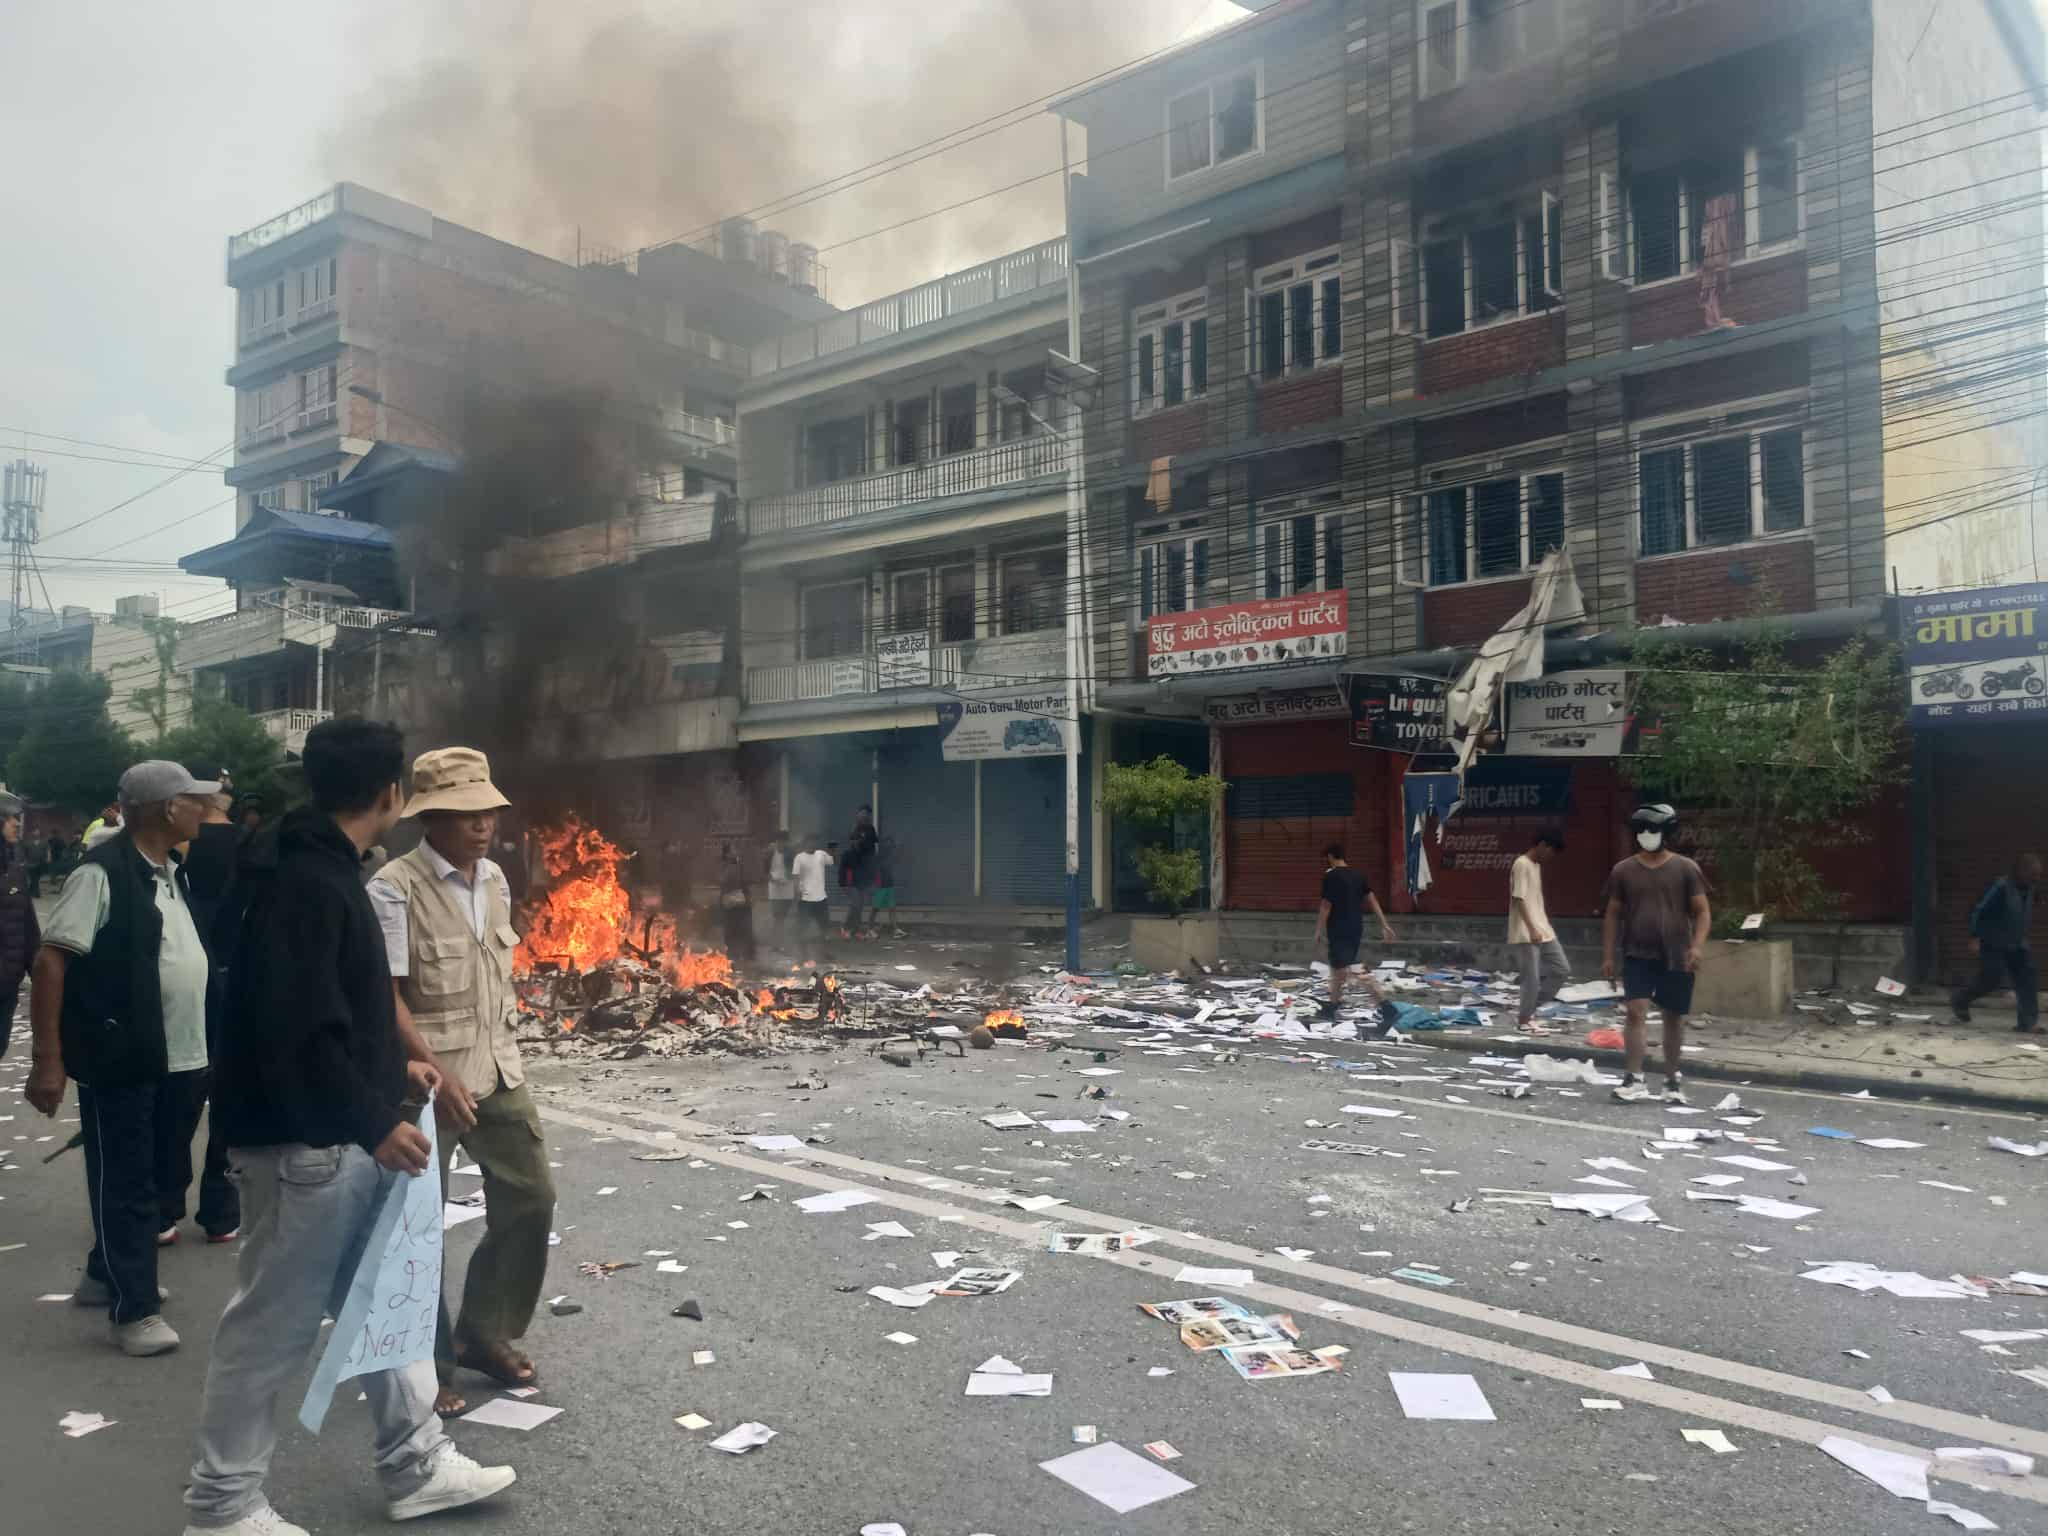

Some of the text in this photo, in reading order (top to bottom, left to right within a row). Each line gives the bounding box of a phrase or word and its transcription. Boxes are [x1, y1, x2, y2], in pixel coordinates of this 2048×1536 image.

[1916, 608, 2038, 644] मामा
[1574, 678, 1617, 697] मोटर
[966, 703, 988, 715] Auto
[990, 701, 1012, 714] Guru
[1014, 698, 1045, 712] Motor
